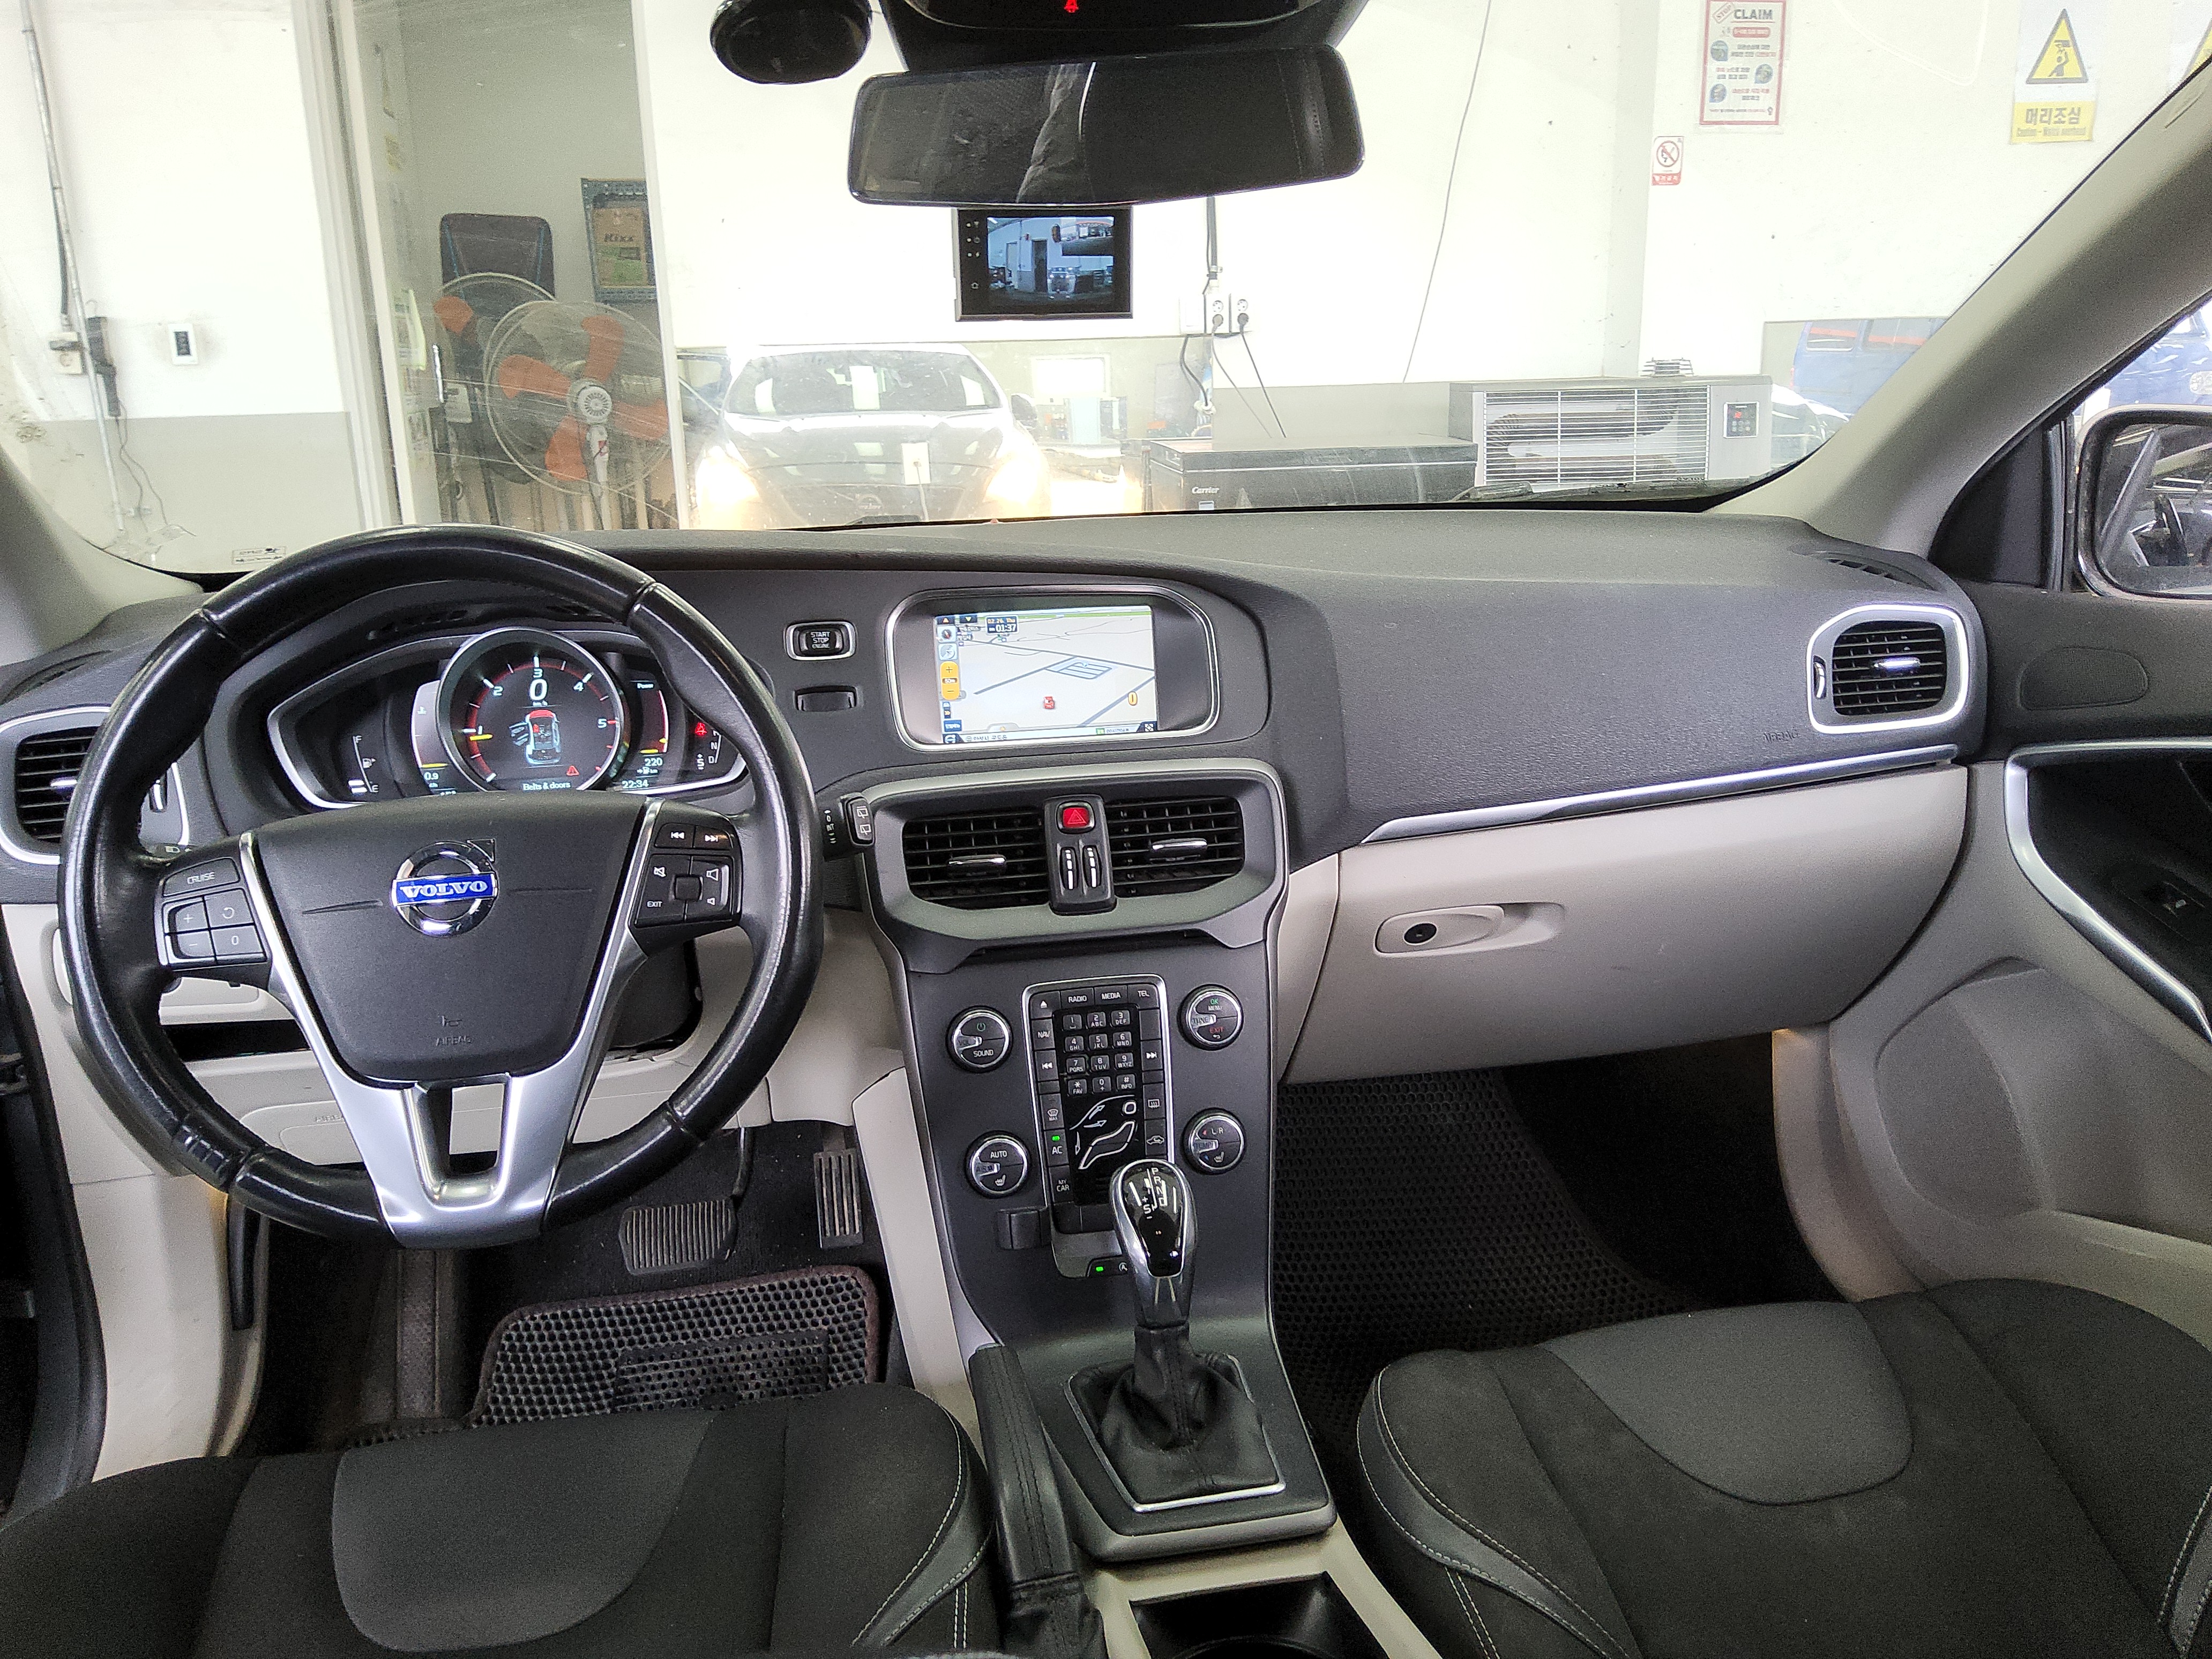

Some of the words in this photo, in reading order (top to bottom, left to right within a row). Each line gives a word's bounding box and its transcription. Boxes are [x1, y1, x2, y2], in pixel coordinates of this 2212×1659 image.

[1734, 9, 1773, 20] CLAIM
[2026, 107, 2081, 125] 머리조심
[996, 624, 1017, 632] 01:37
[534, 669, 543, 678] 3
[493, 686, 503, 696] 2
[529, 678, 548, 700] 0
[573, 682, 584, 692] 4
[598, 719, 607, 728] 5
[711, 742, 718, 750] N
[645, 758, 663, 766] 220
[697, 759, 705, 767] S
[424, 772, 439, 780] 0.9
[372, 784, 379, 793] E
[622, 780, 649, 788] 22:34
[187, 872, 215, 884] CRUISE
[400, 880, 488, 898] VOLVO
[1068, 995, 1087, 1003] RADIO
[1101, 992, 1121, 1000] MEDIA
[1037, 1030, 1050, 1038] NAV
[973, 1049, 994, 1057] SOUND
[990, 1150, 1007, 1159] AUTO
[1052, 1146, 1063, 1155] AC
[1153, 1176, 1162, 1184] R
[1056, 1184, 1070, 1192] CAR
[1156, 1186, 1164, 1195] N
[1143, 1204, 1152, 1214] S
